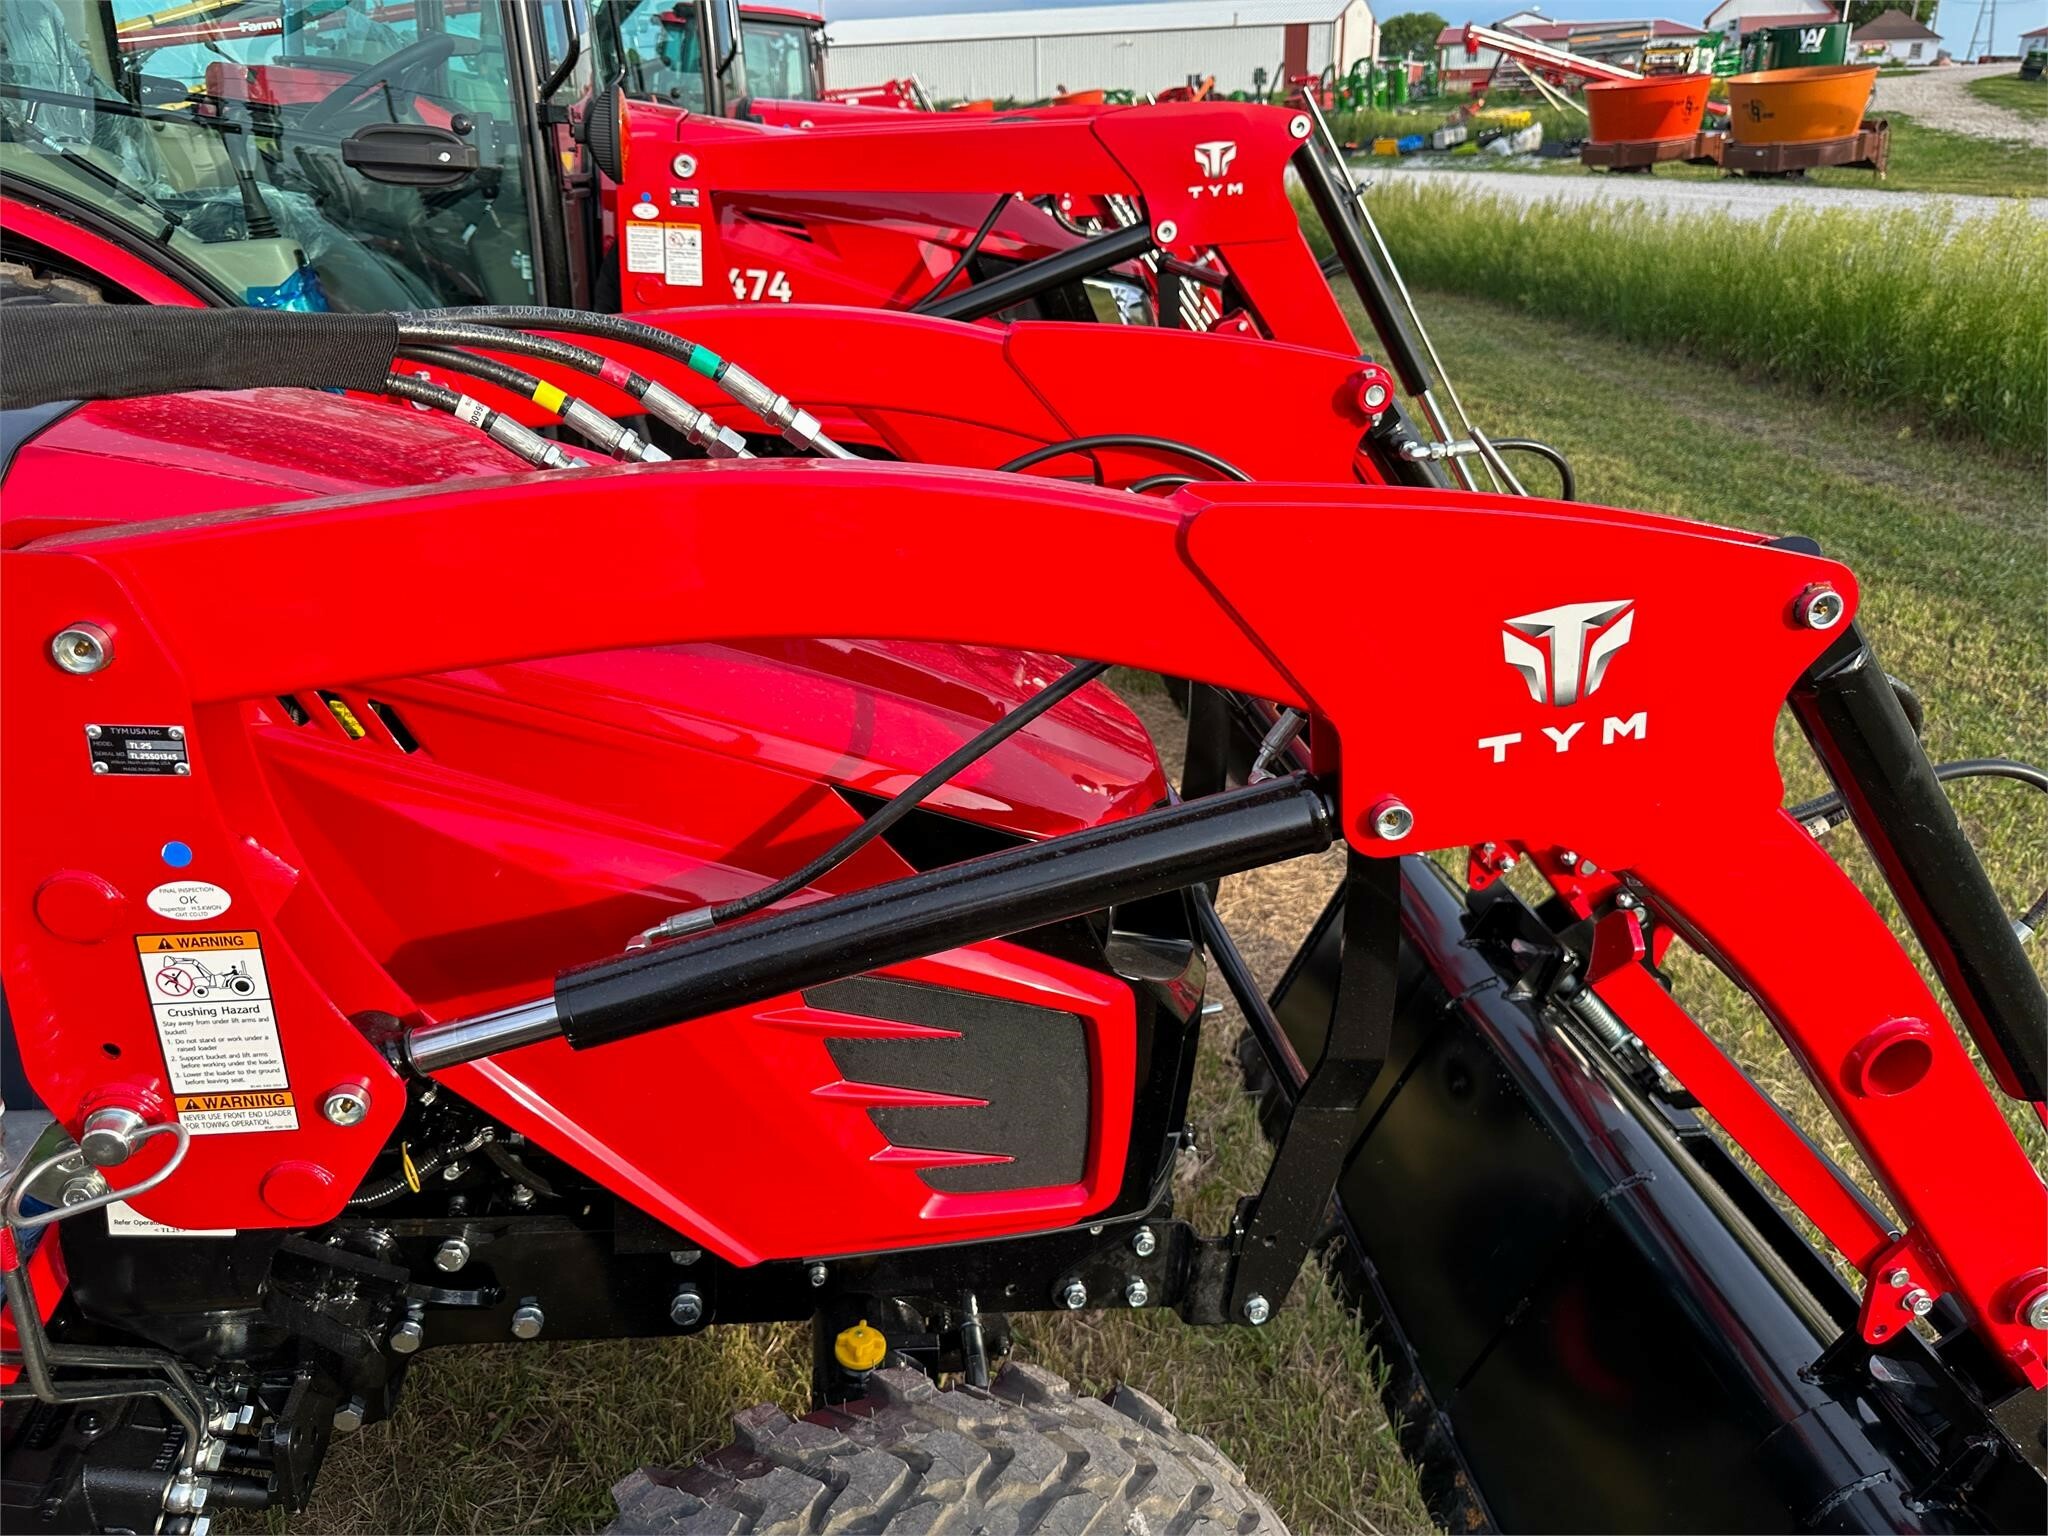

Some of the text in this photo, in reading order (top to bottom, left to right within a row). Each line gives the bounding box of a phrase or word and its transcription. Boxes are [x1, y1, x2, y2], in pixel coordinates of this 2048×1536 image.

[239, 21, 276, 32] Farm
[1187, 182, 1243, 199] TYM
[472, 306, 499, 315] SAE
[1478, 712, 1648, 763] TYM
[129, 742, 152, 750] TL25
[179, 896, 198, 904] OK
[177, 936, 244, 948] WARNING
[168, 1005, 260, 1017] Crushing Hazard
[202, 1094, 285, 1109] WARNING
[186, 1122, 200, 1130] FOR
[231, 1119, 270, 1127] OPERATION.
